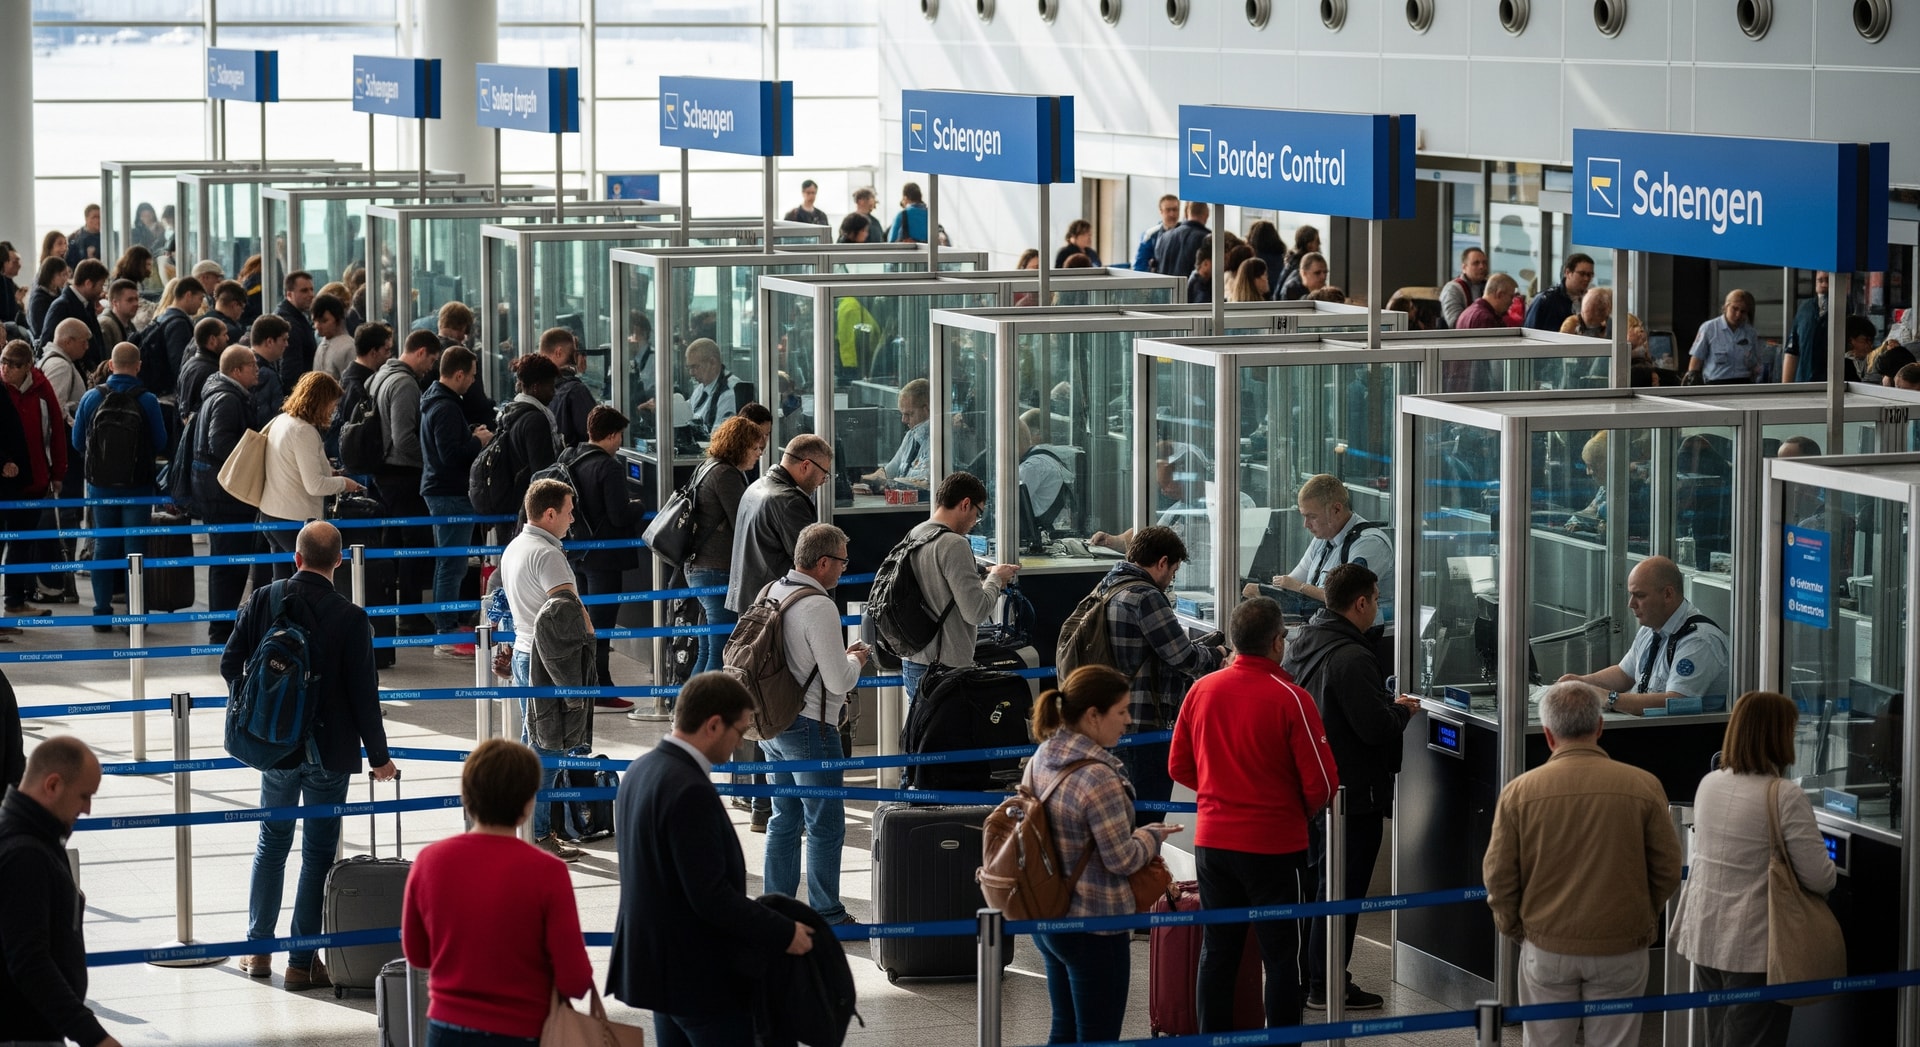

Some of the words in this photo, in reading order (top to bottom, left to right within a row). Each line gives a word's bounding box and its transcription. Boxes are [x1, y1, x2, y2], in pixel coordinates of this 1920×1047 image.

[682, 100, 734, 139] Schengen
[933, 118, 1001, 162] Schengen
[1218, 139, 1274, 179] Border
[1280, 144, 1346, 188] Control
[1632, 170, 1763, 235] Schengen
